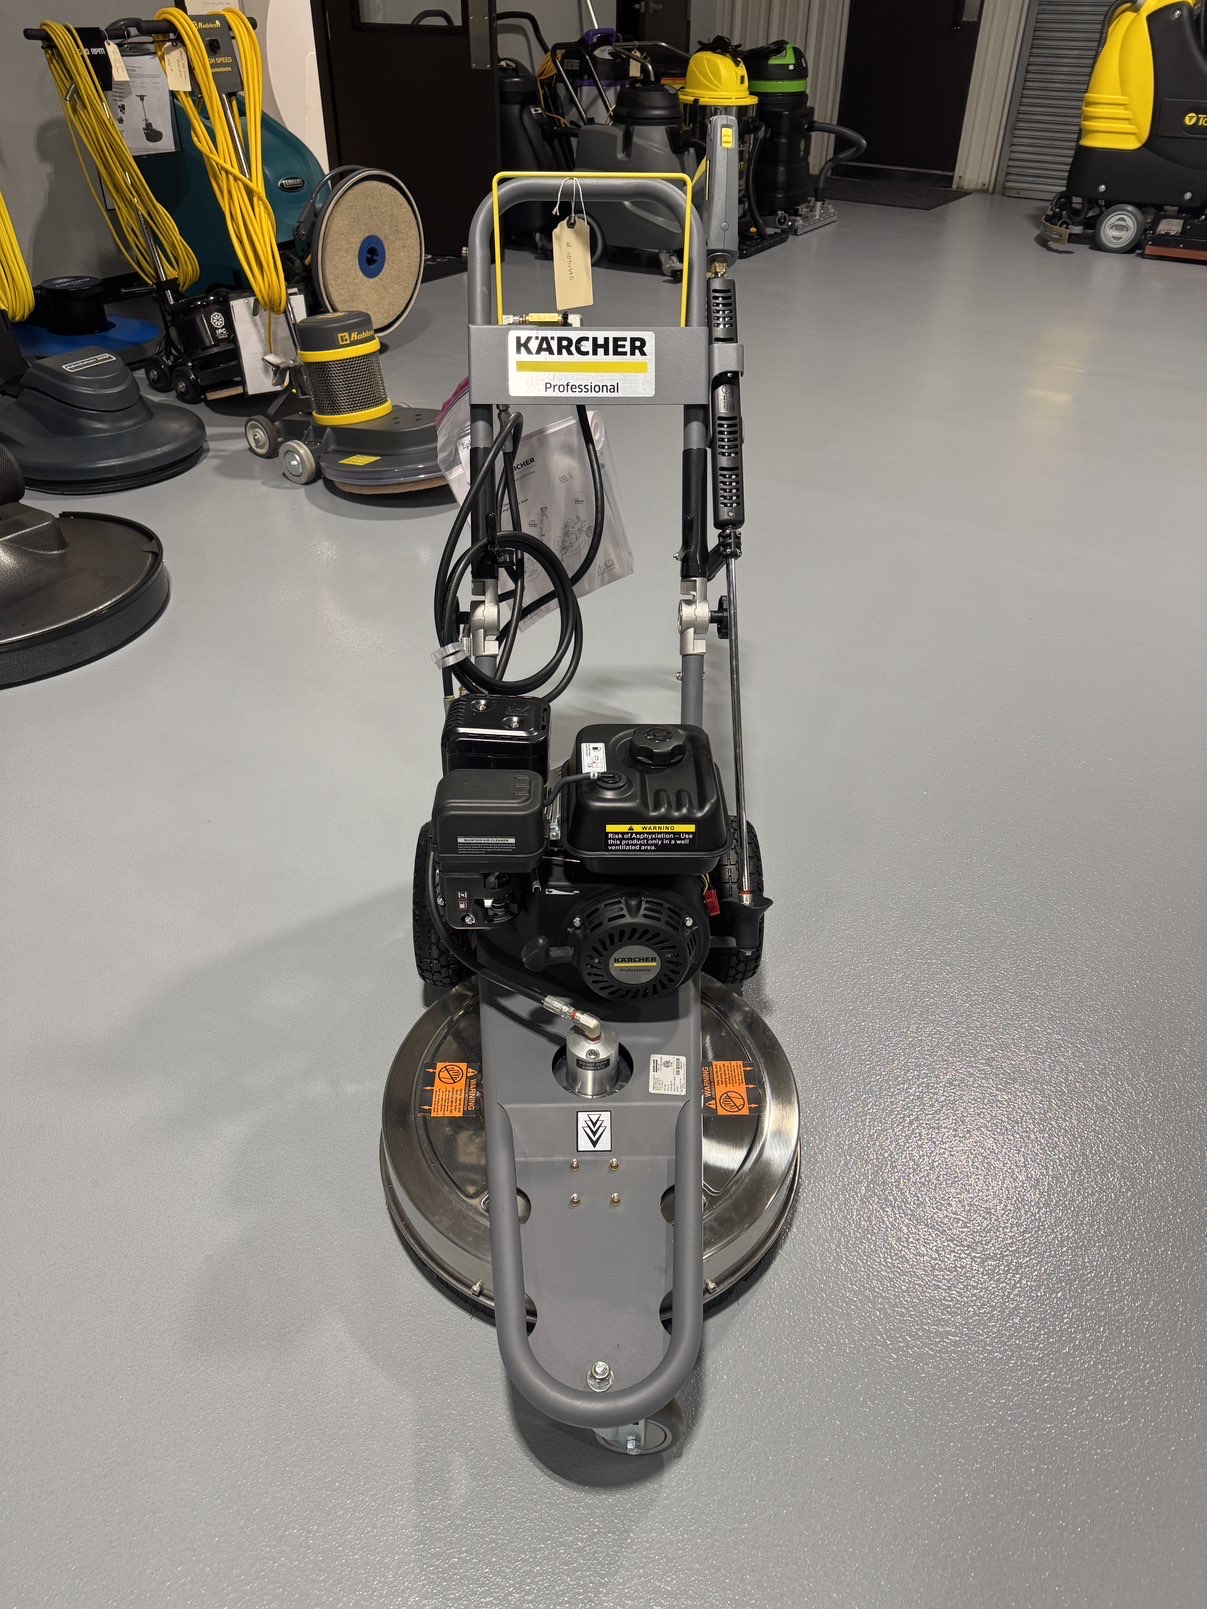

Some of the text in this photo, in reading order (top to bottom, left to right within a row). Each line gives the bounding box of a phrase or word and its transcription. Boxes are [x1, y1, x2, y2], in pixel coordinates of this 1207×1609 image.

[216, 56, 232, 64] SPEED
[515, 335, 648, 357] KÄRCHER
[544, 382, 619, 394] Professional
[512, 457, 536, 472] RCHER
[702, 1066, 711, 1098] WARNING
[467, 1078, 477, 1110] WARNING
